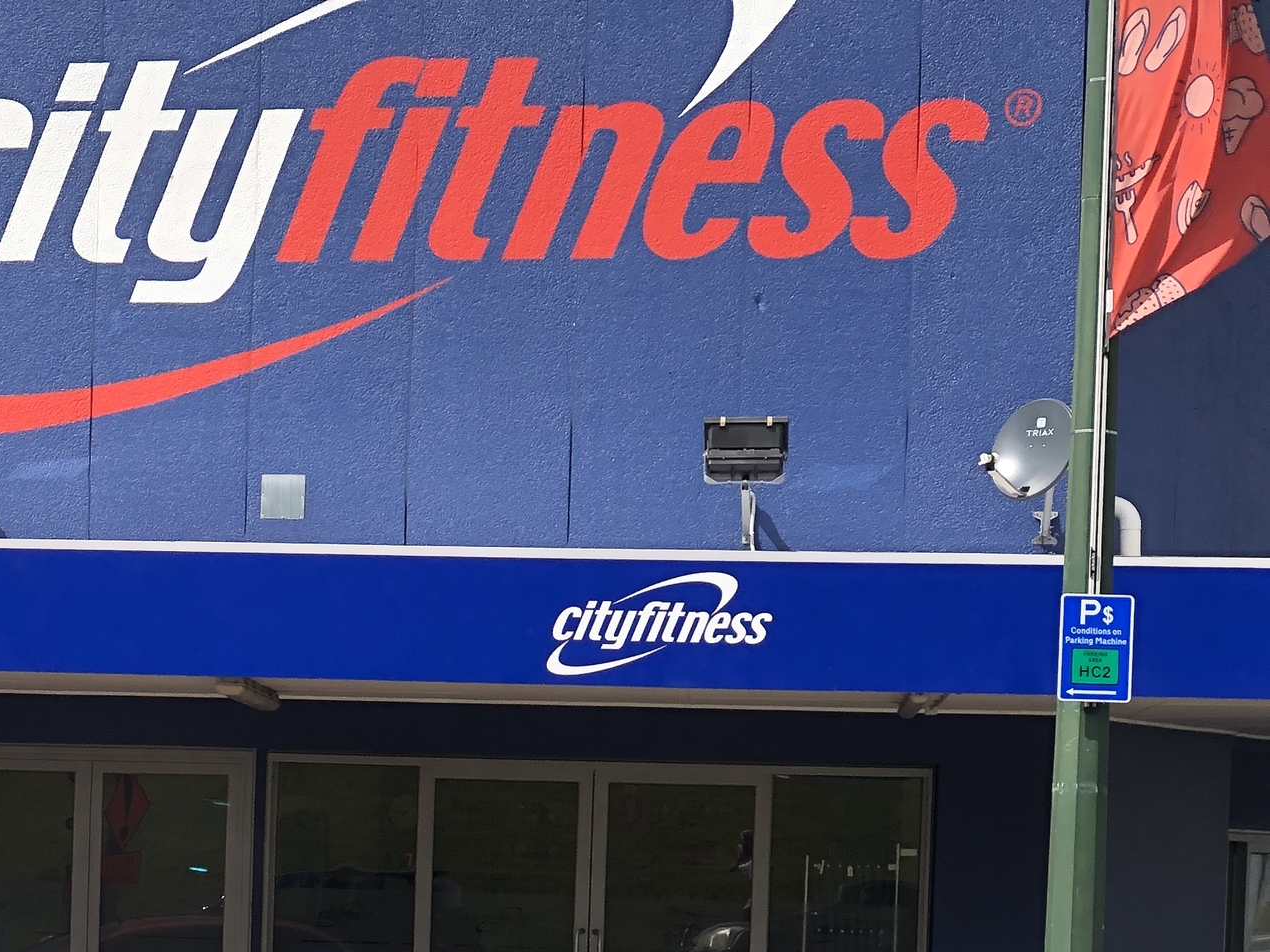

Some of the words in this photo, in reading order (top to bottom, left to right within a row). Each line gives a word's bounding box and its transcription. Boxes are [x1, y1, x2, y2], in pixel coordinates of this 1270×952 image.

[1026, 429, 1055, 437] TRIAX
[552, 600, 773, 650] cityfitness
[1070, 626, 1111, 636] Conditions
[1112, 628, 1122, 636] on
[1065, 636, 1093, 646] Parking
[1095, 637, 1127, 645] Machine
[1079, 665, 1111, 678] HC2
